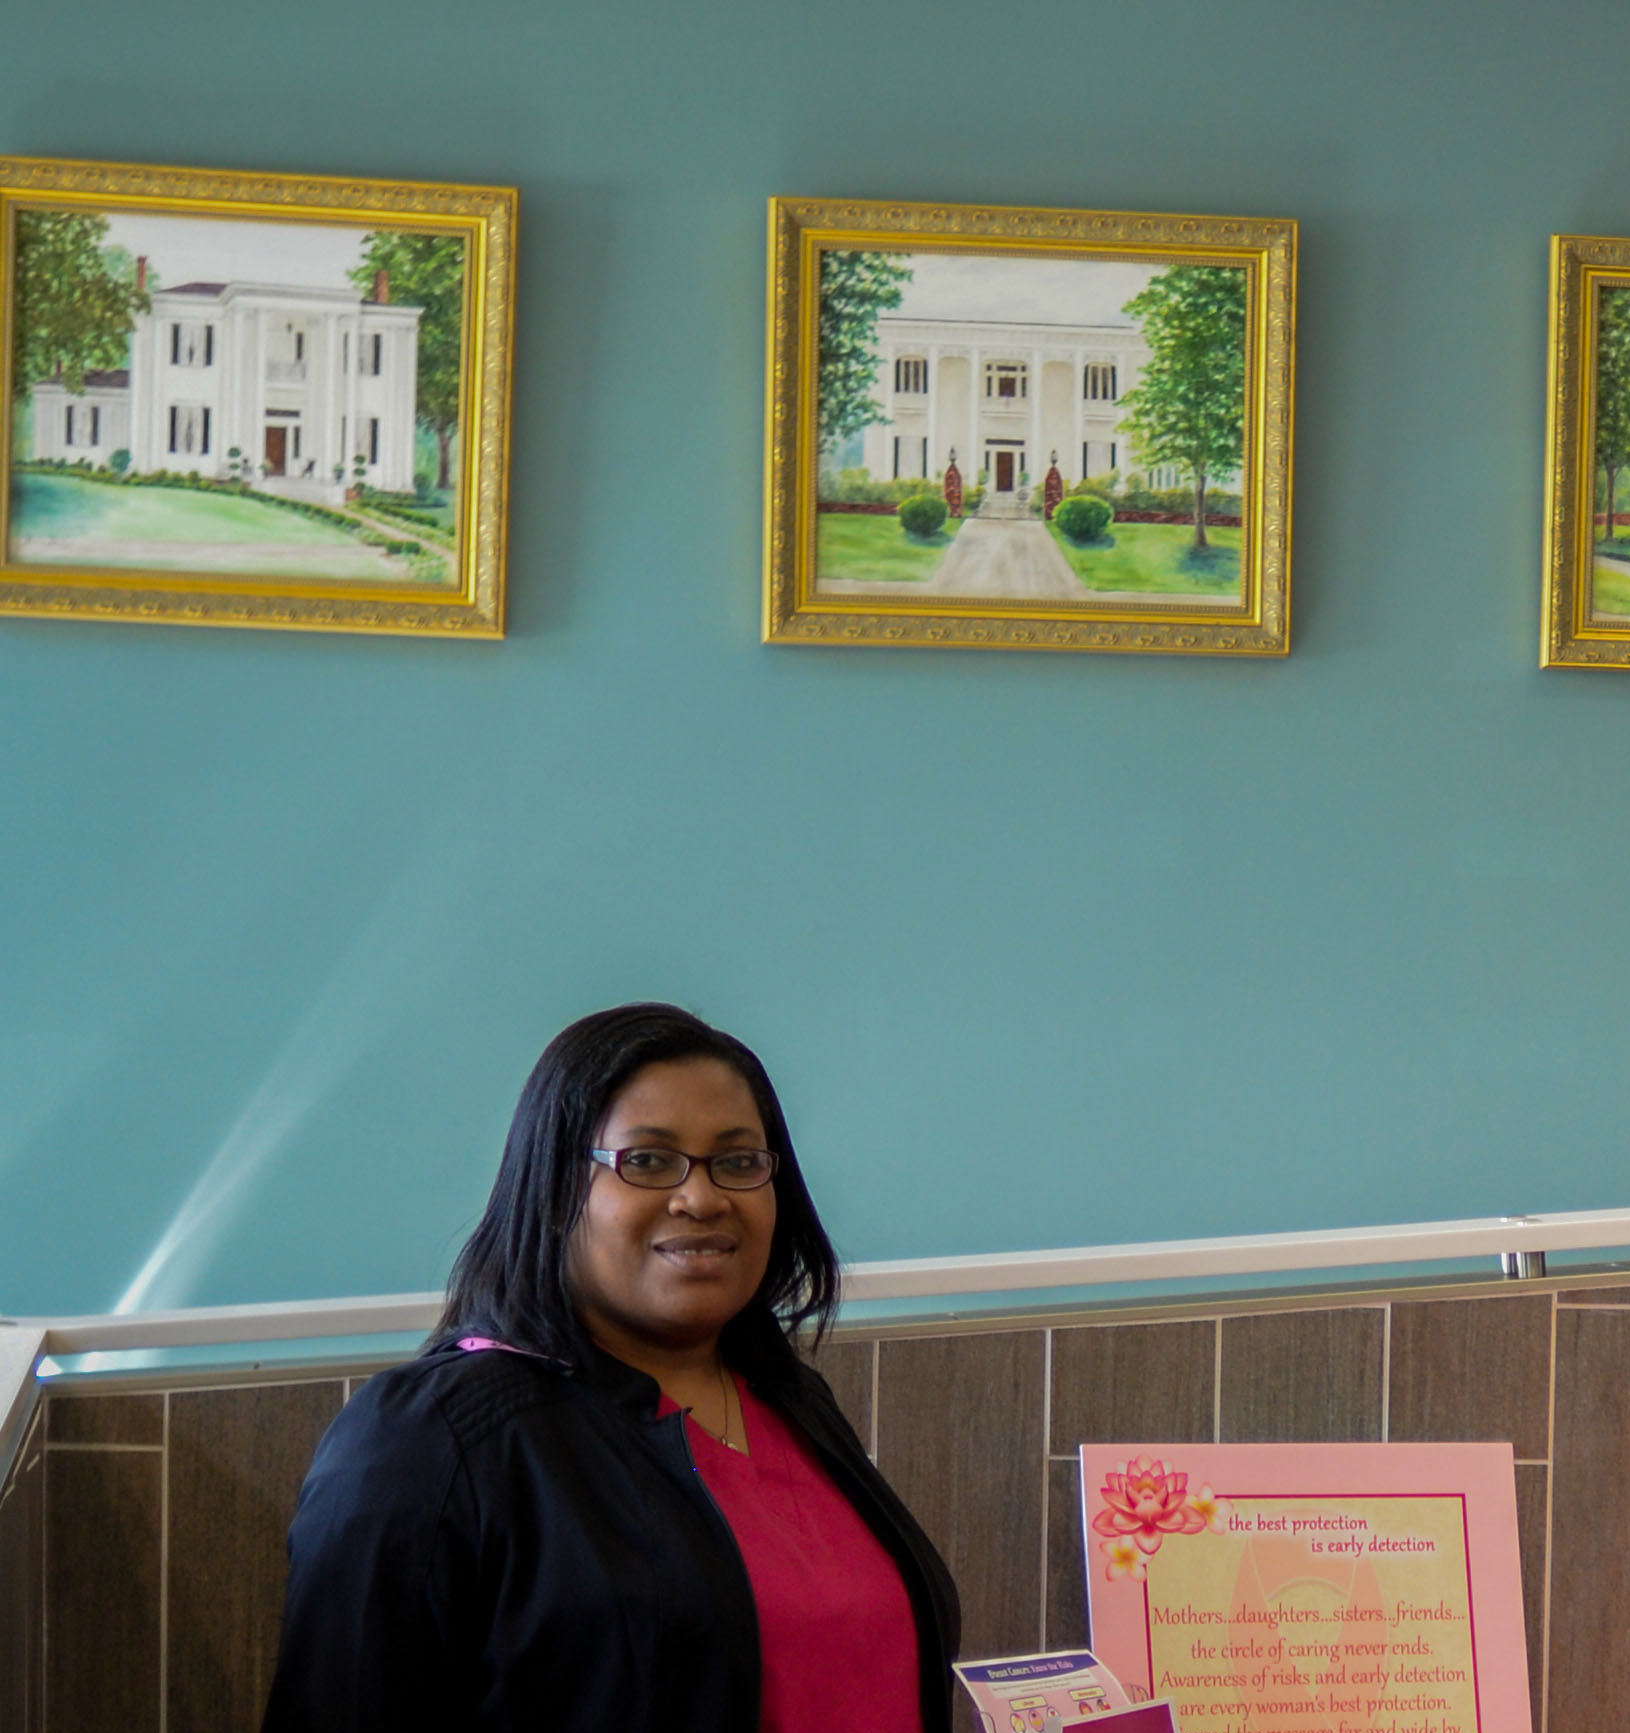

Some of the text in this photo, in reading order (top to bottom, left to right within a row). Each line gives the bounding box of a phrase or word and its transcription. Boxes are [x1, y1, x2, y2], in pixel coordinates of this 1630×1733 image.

[1229, 1514, 1368, 1535] the best protection
[1311, 1536, 1436, 1557] is early detection
[1192, 1636, 1434, 1663] the circle of caring never ends.
[1160, 1664, 1466, 1692] Awareness of risks and early detection
[1180, 1694, 1451, 1720] are every woman's best protection.
